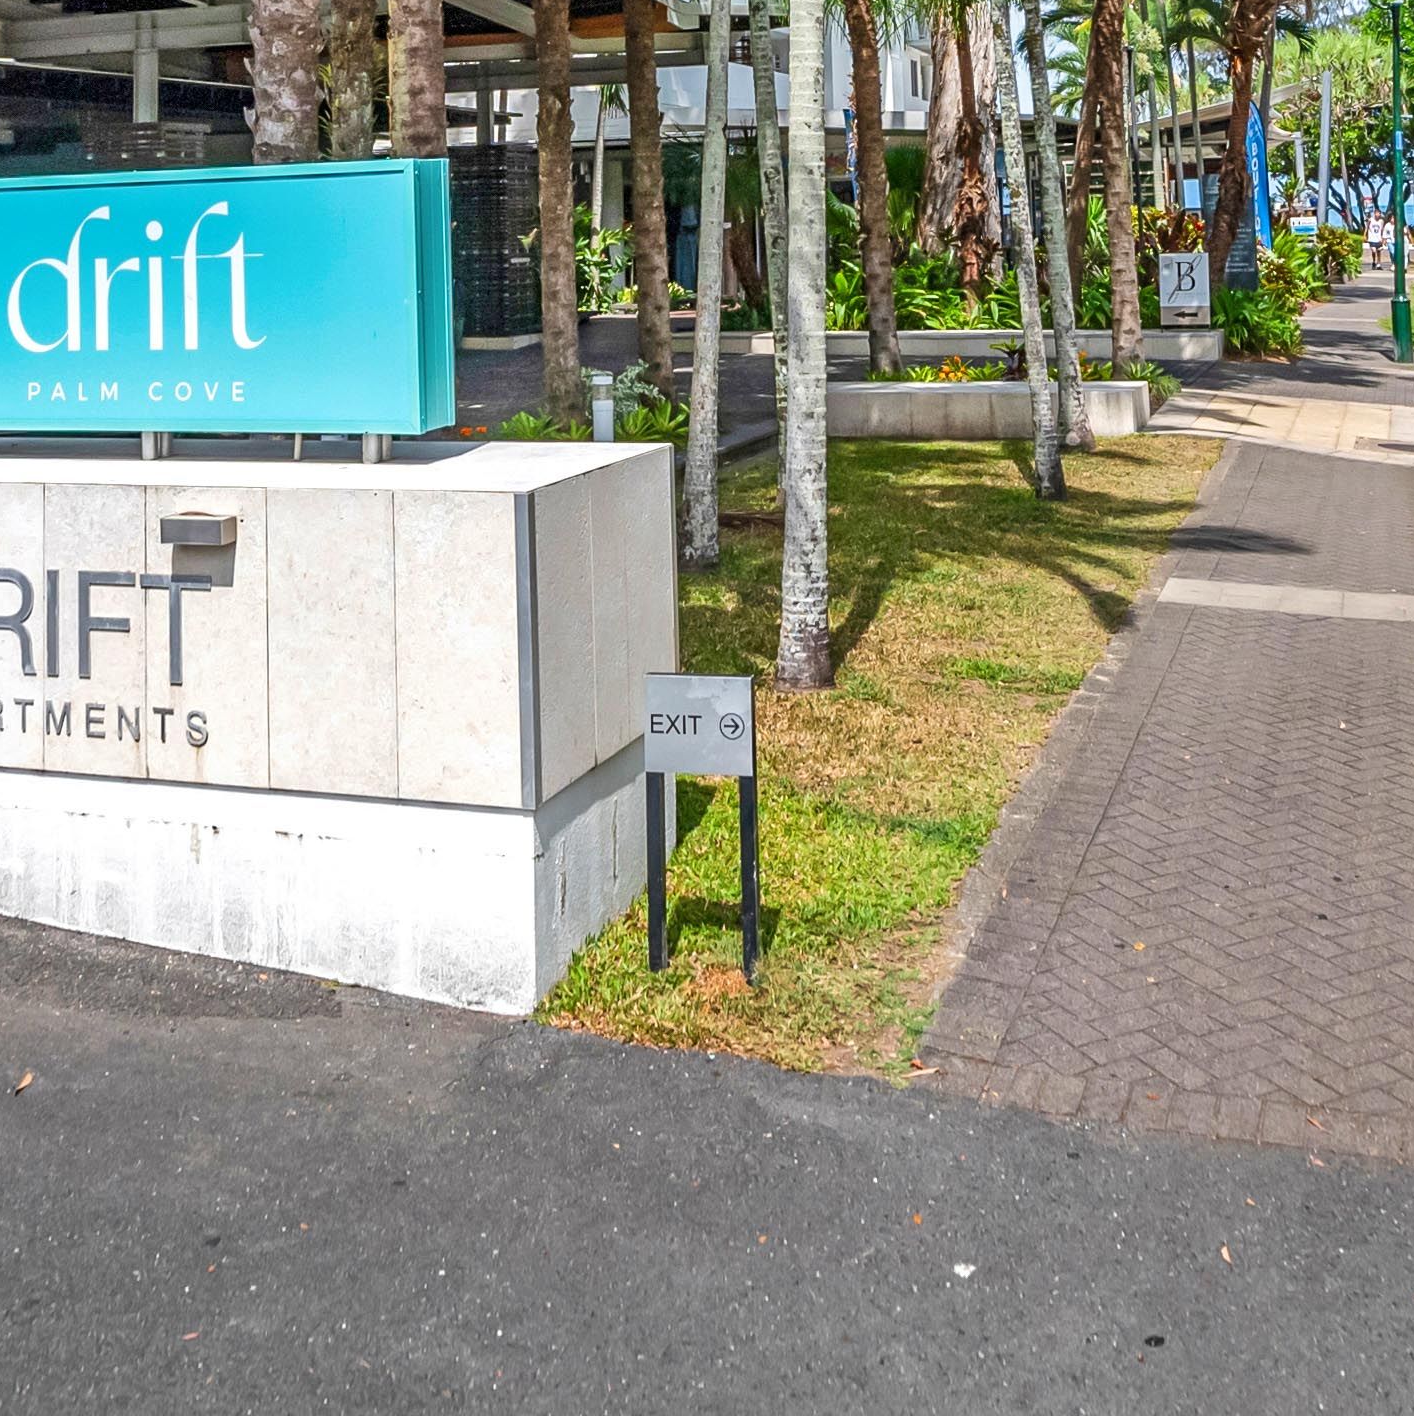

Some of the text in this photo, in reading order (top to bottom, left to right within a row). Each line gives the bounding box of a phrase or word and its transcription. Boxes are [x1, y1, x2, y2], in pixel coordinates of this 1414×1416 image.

[7, 201, 267, 354] drift
[27, 380, 246, 403] PALM COVE
[650, 713, 703, 735] EXIT
